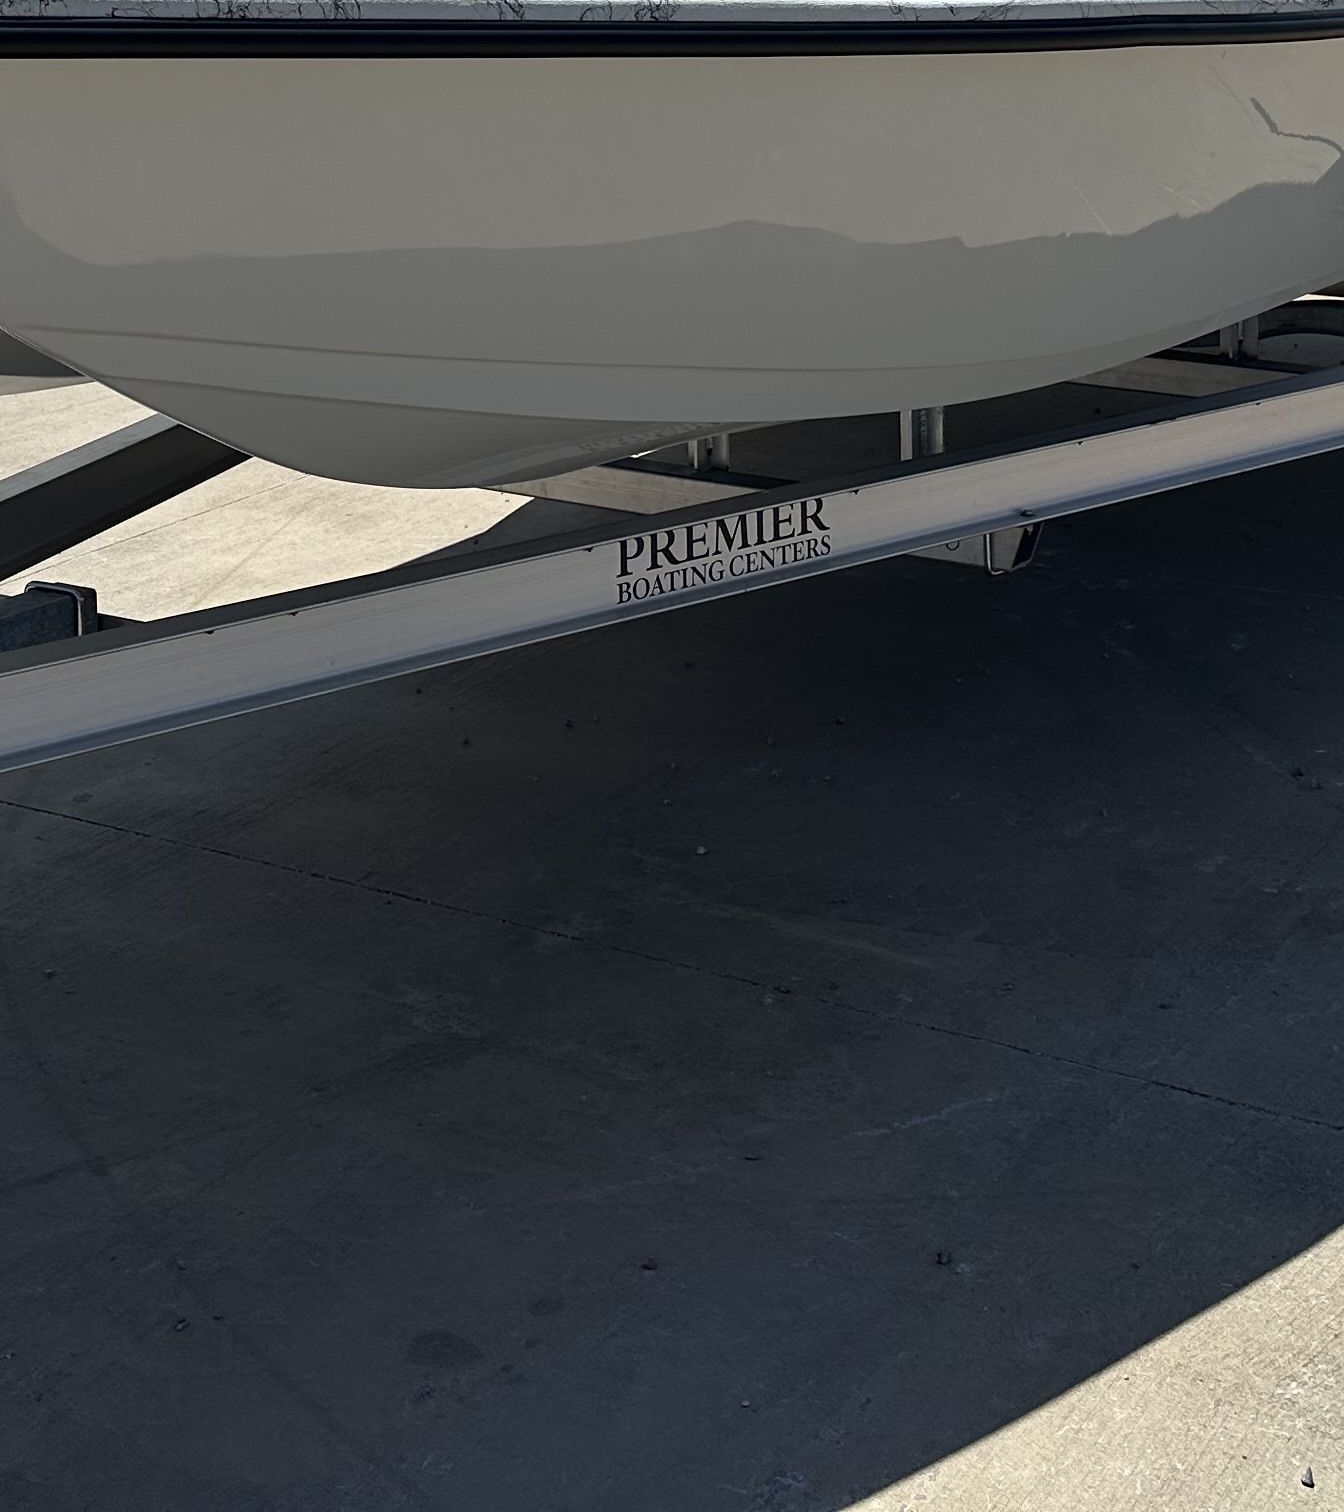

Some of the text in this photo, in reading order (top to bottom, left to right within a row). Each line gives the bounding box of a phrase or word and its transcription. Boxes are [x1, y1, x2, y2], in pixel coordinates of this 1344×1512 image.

[616, 497, 831, 579] PREMIER
[616, 534, 831, 605] BOATING CENTERS
